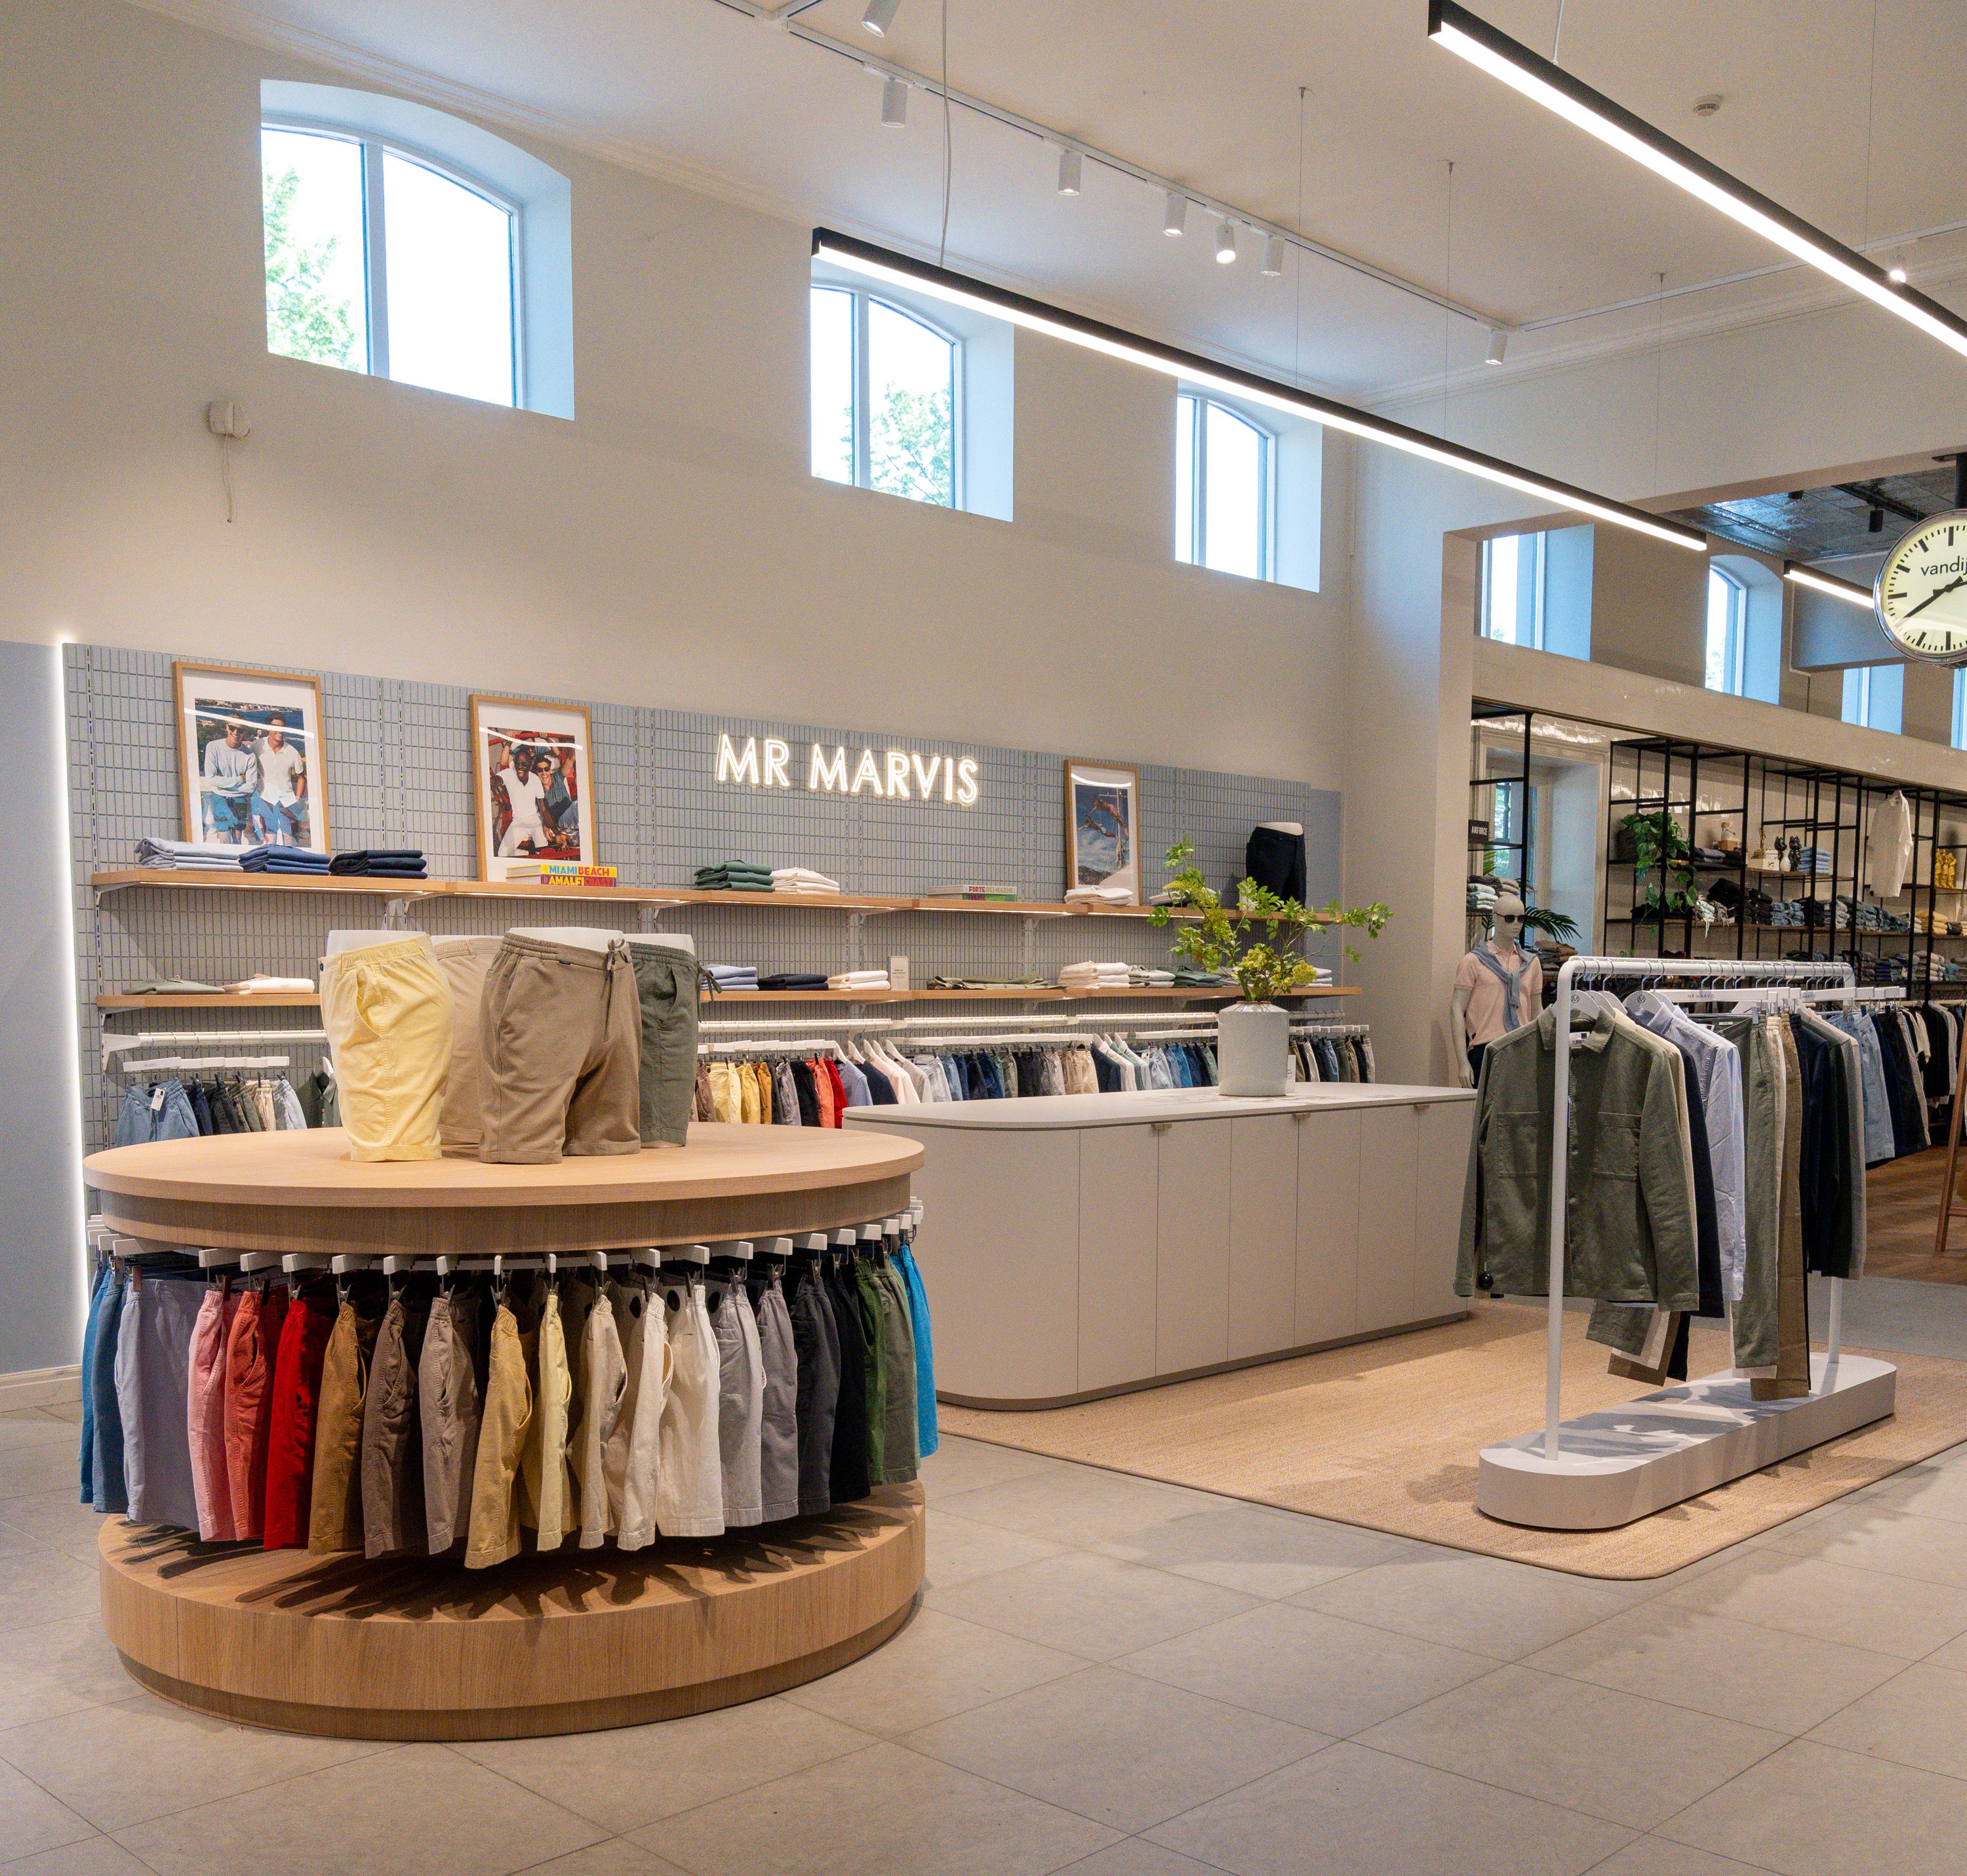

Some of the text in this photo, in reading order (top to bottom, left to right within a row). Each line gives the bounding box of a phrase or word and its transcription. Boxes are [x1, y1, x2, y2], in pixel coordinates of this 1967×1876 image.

[717, 734, 978, 803] MR MARVIS
[549, 866, 610, 876] MIAMI BEACH
[549, 876, 584, 886] AMALFI
